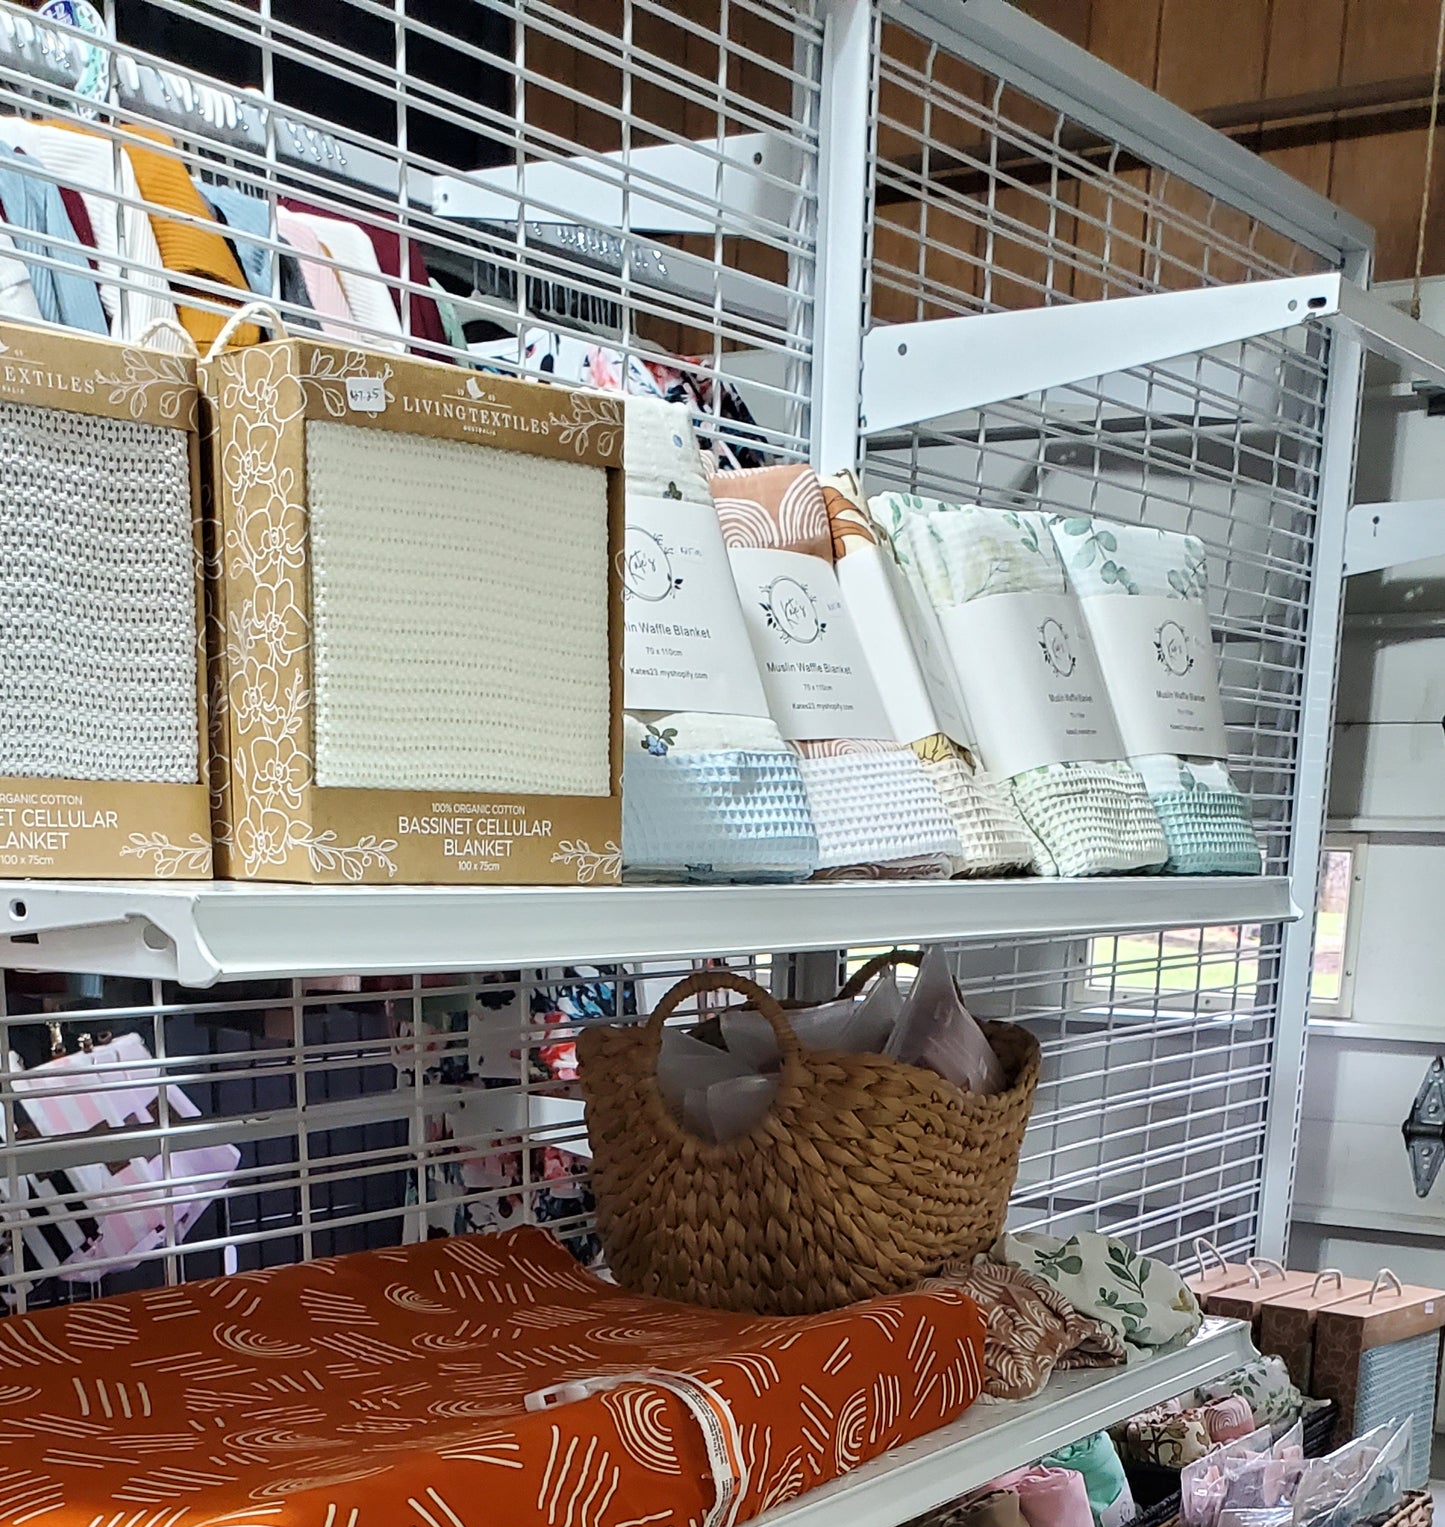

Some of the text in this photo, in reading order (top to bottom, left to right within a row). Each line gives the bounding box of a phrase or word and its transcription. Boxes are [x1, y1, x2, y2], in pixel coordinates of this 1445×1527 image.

[638, 621, 672, 635] Waffle
[673, 624, 711, 639] Blanket
[766, 662, 852, 675] Muslin Waffle Blanket
[40, 794, 83, 806] COTTON
[431, 803, 526, 816] 100% ORGANIC COTTON
[21, 808, 118, 829] CELLULAR
[398, 816, 552, 837] BASSINET CELLULAR
[443, 839, 513, 857] BLANKET
[1, 855, 18, 865] 100
[28, 855, 54, 866] 75cm
[458, 861, 472, 871] 100
[479, 861, 500, 871] 75cm
